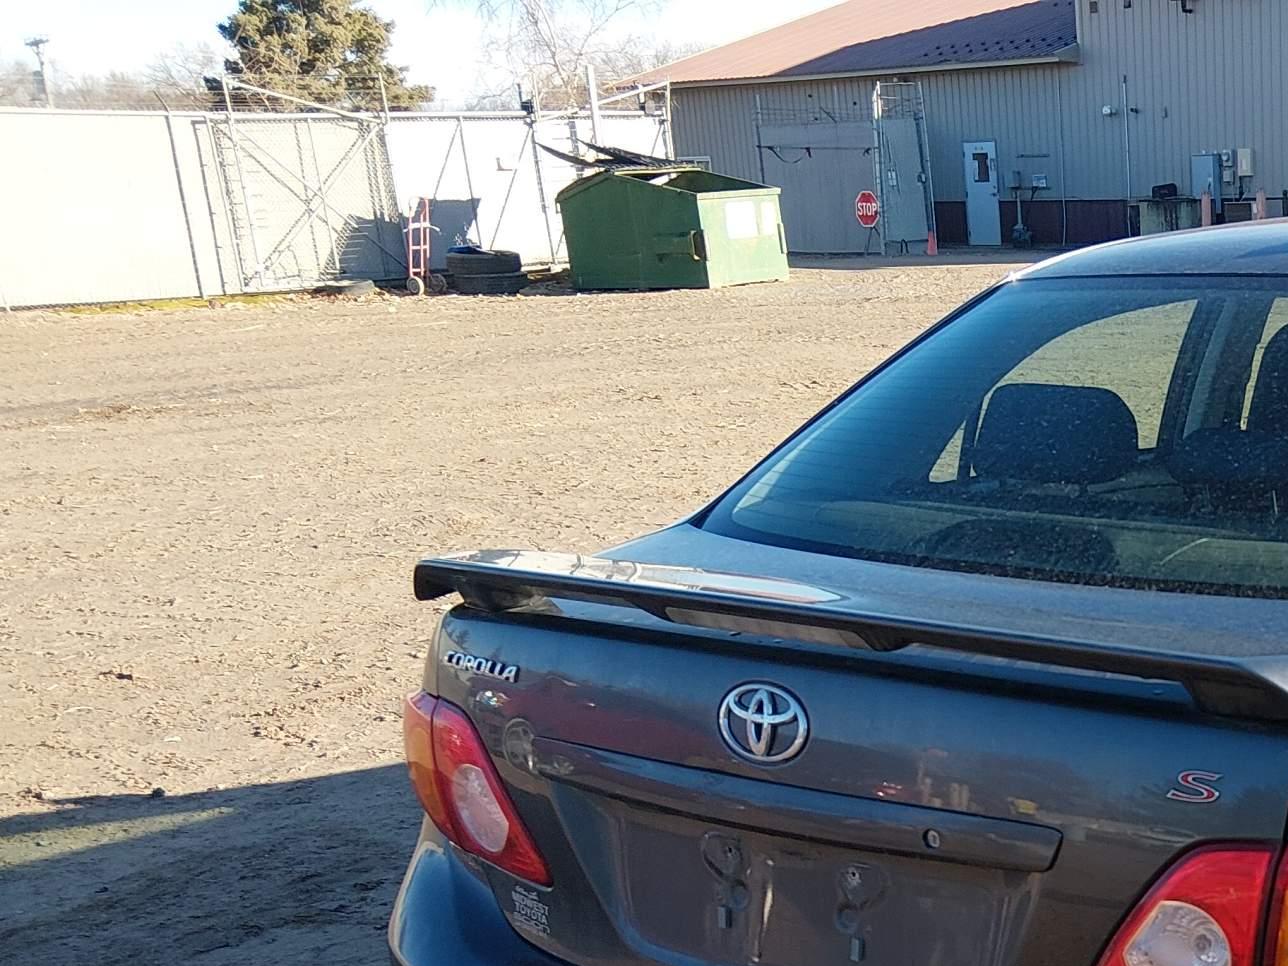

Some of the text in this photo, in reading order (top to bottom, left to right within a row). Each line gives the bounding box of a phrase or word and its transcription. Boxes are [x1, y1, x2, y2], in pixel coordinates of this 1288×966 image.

[857, 202, 878, 216] STOP
[443, 651, 519, 683] COROLLA
[1166, 770, 1224, 803] S
[514, 901, 548, 925] TOYOTA
